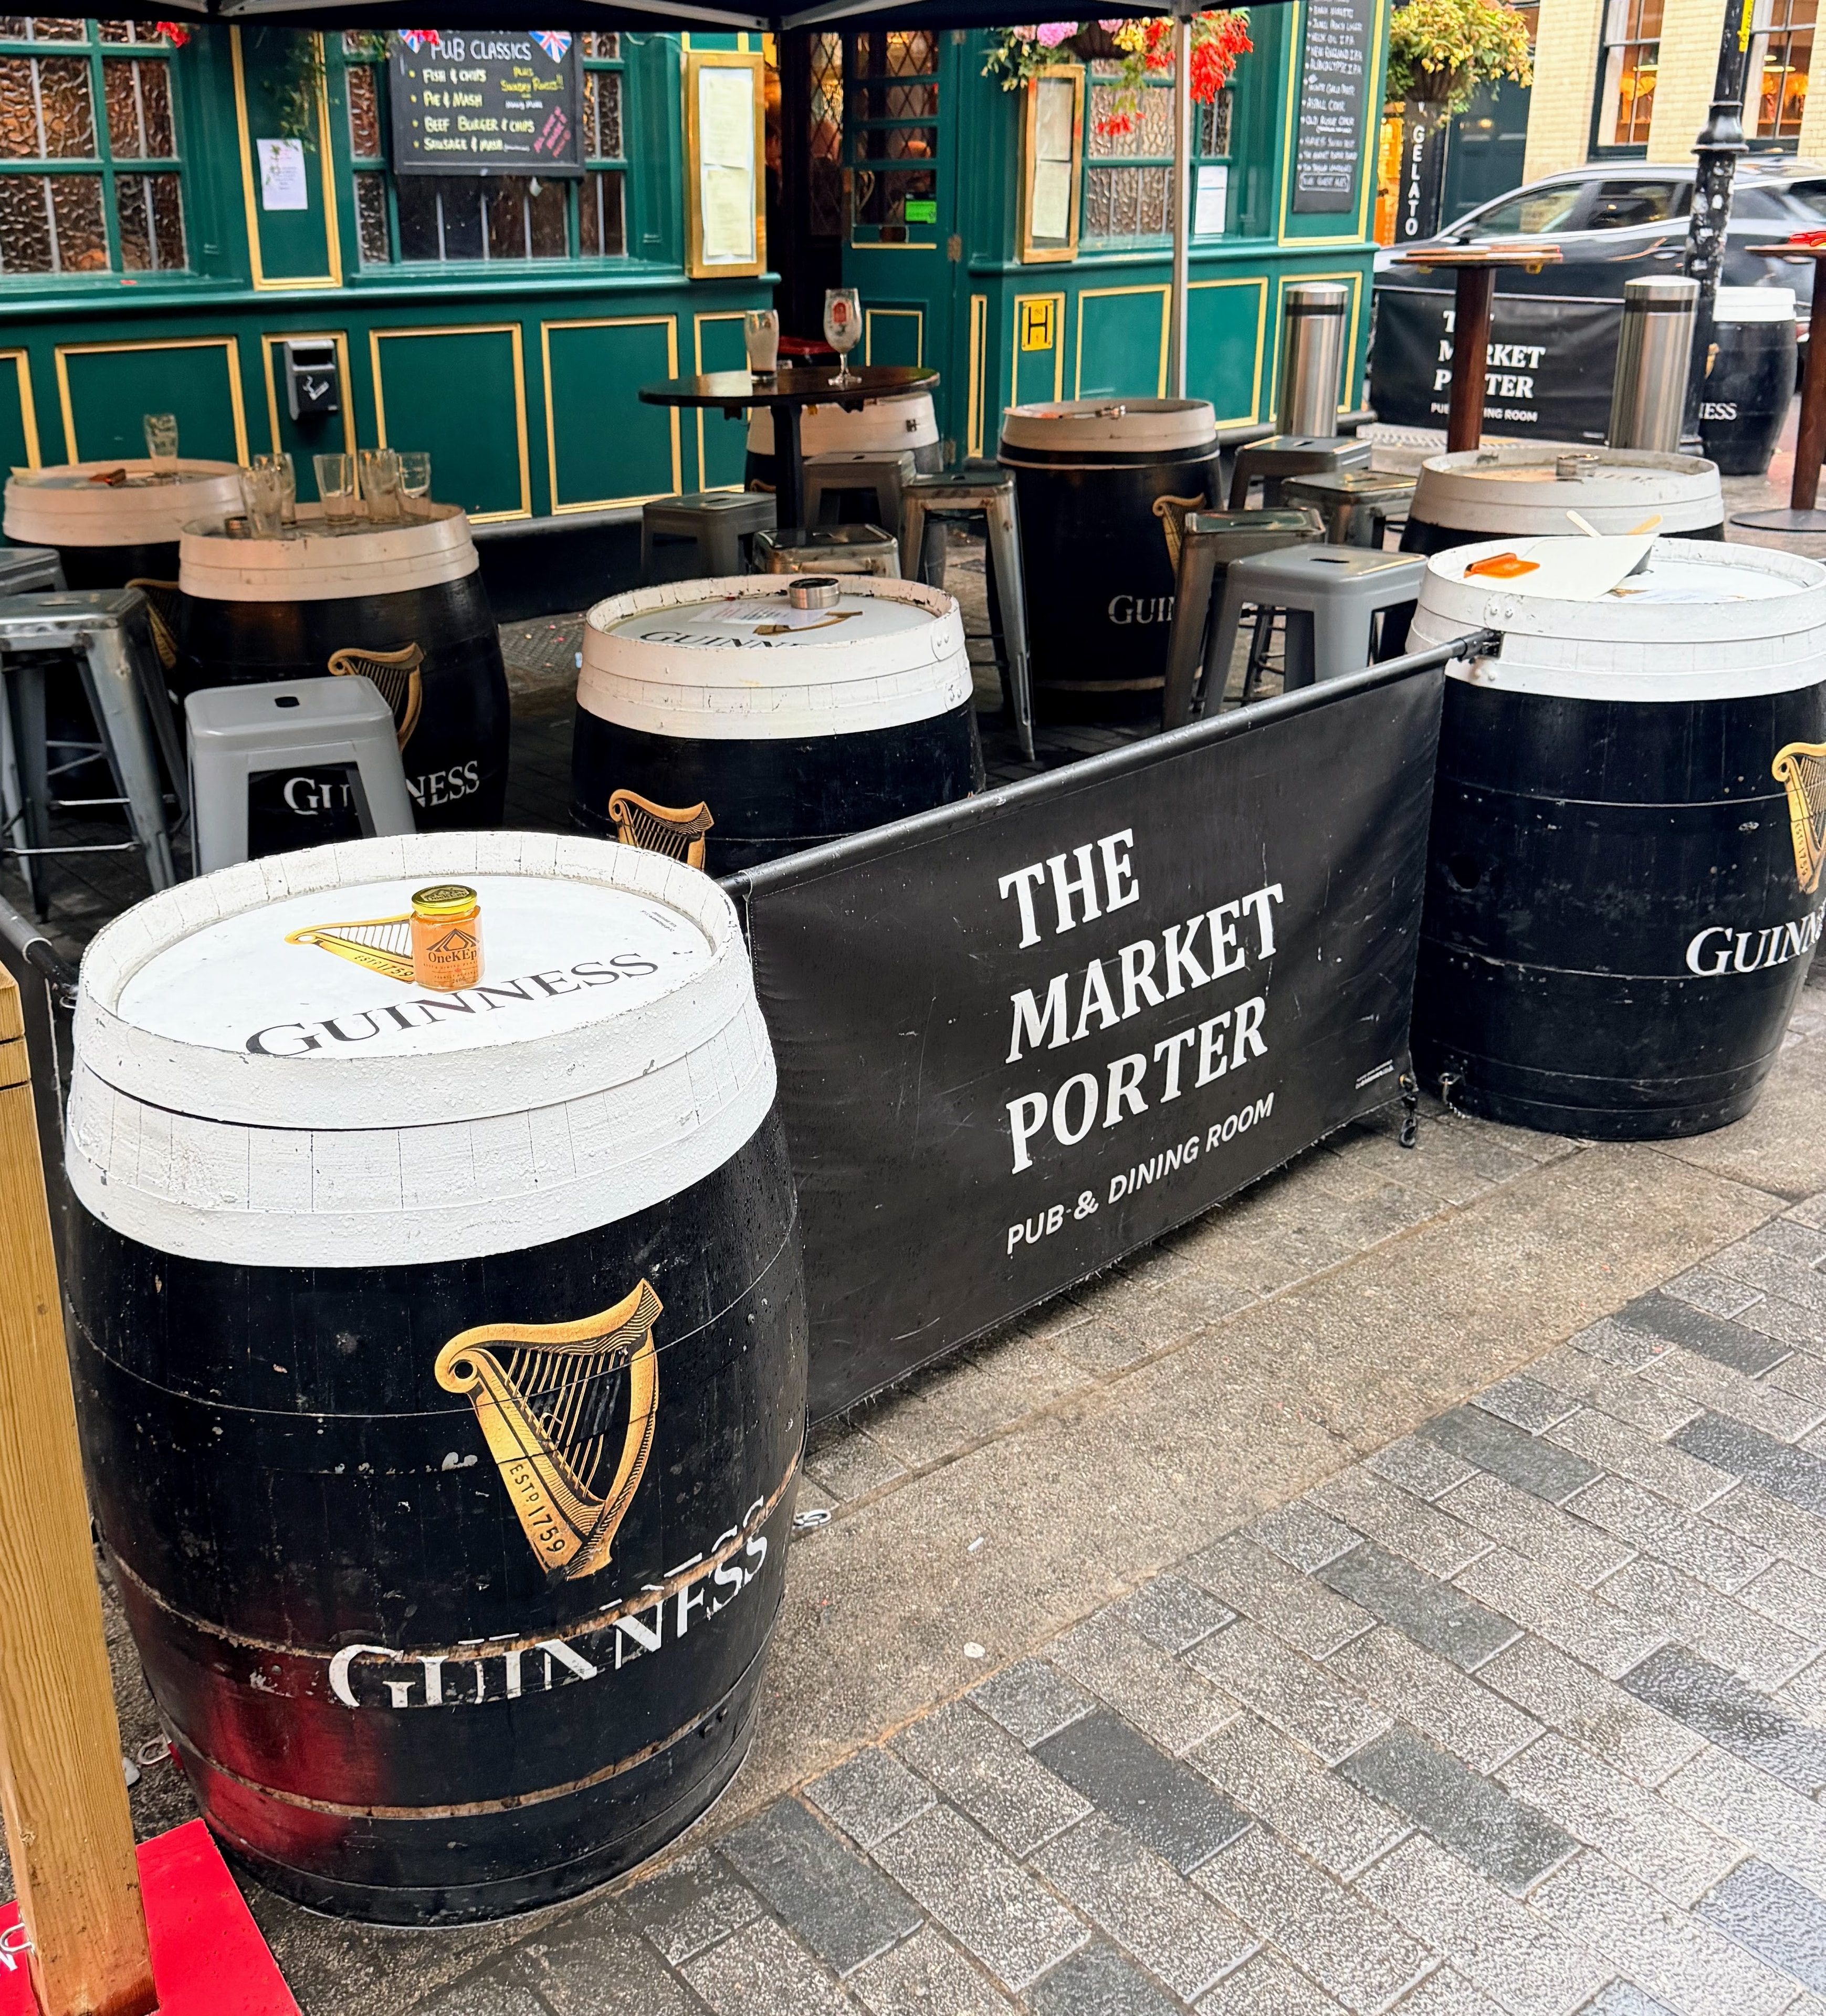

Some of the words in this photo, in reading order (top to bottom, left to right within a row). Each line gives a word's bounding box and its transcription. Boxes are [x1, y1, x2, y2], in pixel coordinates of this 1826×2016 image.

[431, 37, 465, 61] PUB
[470, 38, 532, 61] CLASSICS
[422, 68, 446, 84] FISH
[459, 68, 487, 82] CHIPS
[423, 90, 441, 107] PIE
[453, 90, 482, 108] MASH
[424, 116, 450, 132] BEEF
[457, 115, 499, 131] BURGER
[1405, 124, 1425, 236] GELATO
[1028, 305, 1048, 344] H
[1438, 340, 1546, 369] MRKET
[1433, 369, 1534, 398] PTER
[1505, 409, 1538, 422] ROOM
[998, 828, 1139, 949] THE
[377, 964, 414, 976] 1759
[1005, 884, 1284, 1064] MARKET
[245, 953, 658, 1056] GUINNESS
[1006, 996, 1268, 1175] PORTER
[1007, 1205, 1064, 1254] PUB
[1074, 1191, 1098, 1220] &
[1108, 1136, 1198, 1204] DINING
[1205, 1092, 1274, 1152] ROOM
[528, 1506, 565, 1552] 1759
[329, 1495, 768, 1708] GUINNESS
